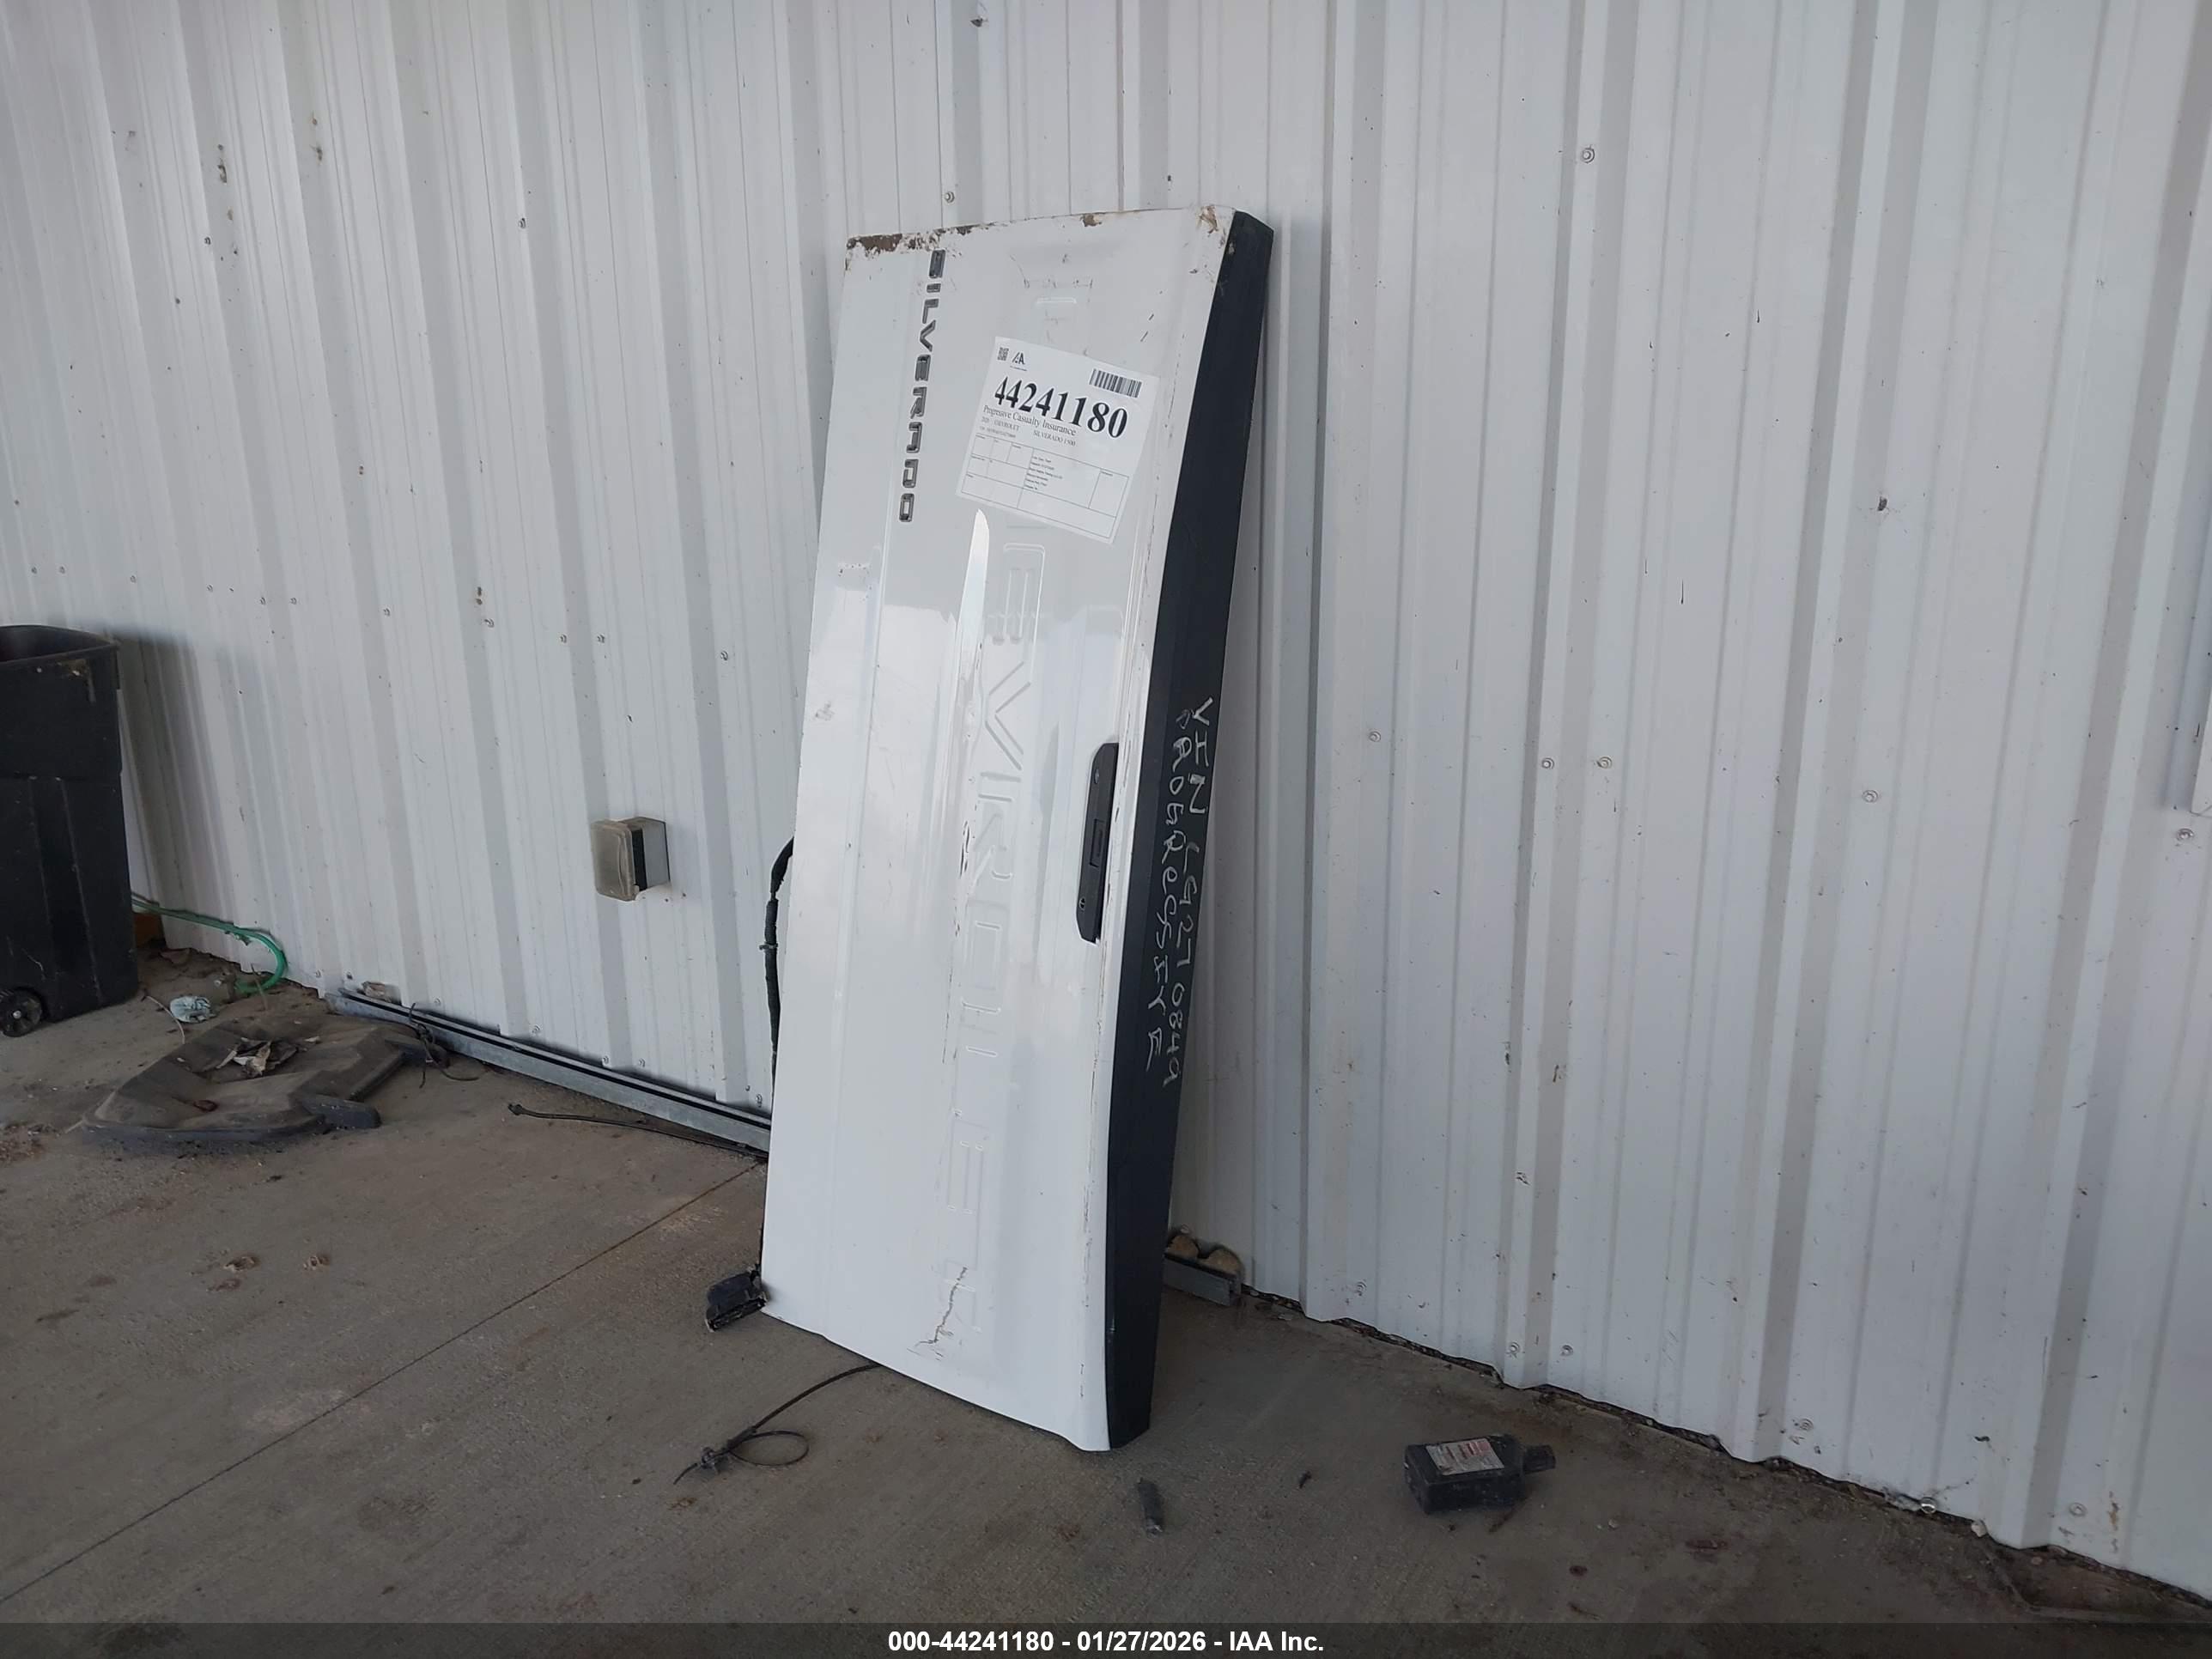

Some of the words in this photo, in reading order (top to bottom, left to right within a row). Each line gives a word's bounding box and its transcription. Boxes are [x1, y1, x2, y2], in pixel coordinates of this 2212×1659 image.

[898, 249, 946, 523] SILVERADO
[994, 375, 1128, 439] 44241180
[1012, 412, 1040, 428] Casualty
[1042, 419, 1077, 436] Insurance
[1188, 696, 1214, 815] VIN
